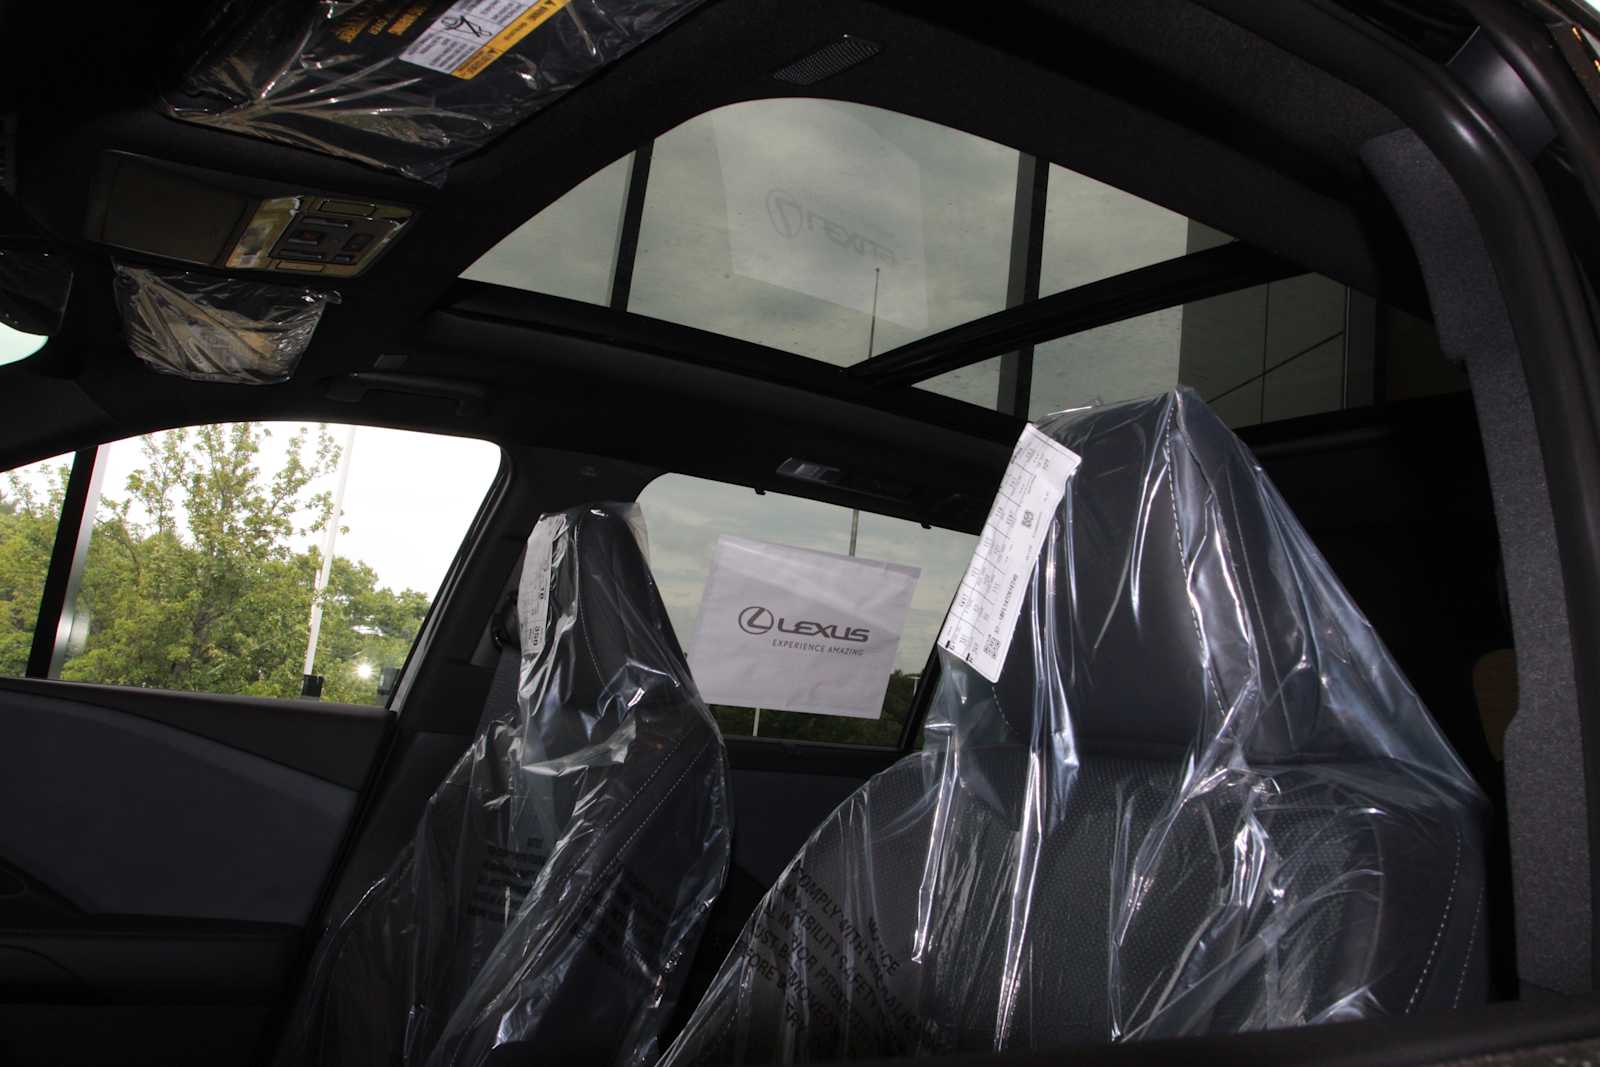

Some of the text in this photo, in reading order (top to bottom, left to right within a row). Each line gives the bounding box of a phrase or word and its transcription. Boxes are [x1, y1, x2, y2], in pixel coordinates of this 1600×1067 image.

[777, 617, 870, 643] LEXUS
[772, 638, 865, 657] EXPERIENCE AMAZING
